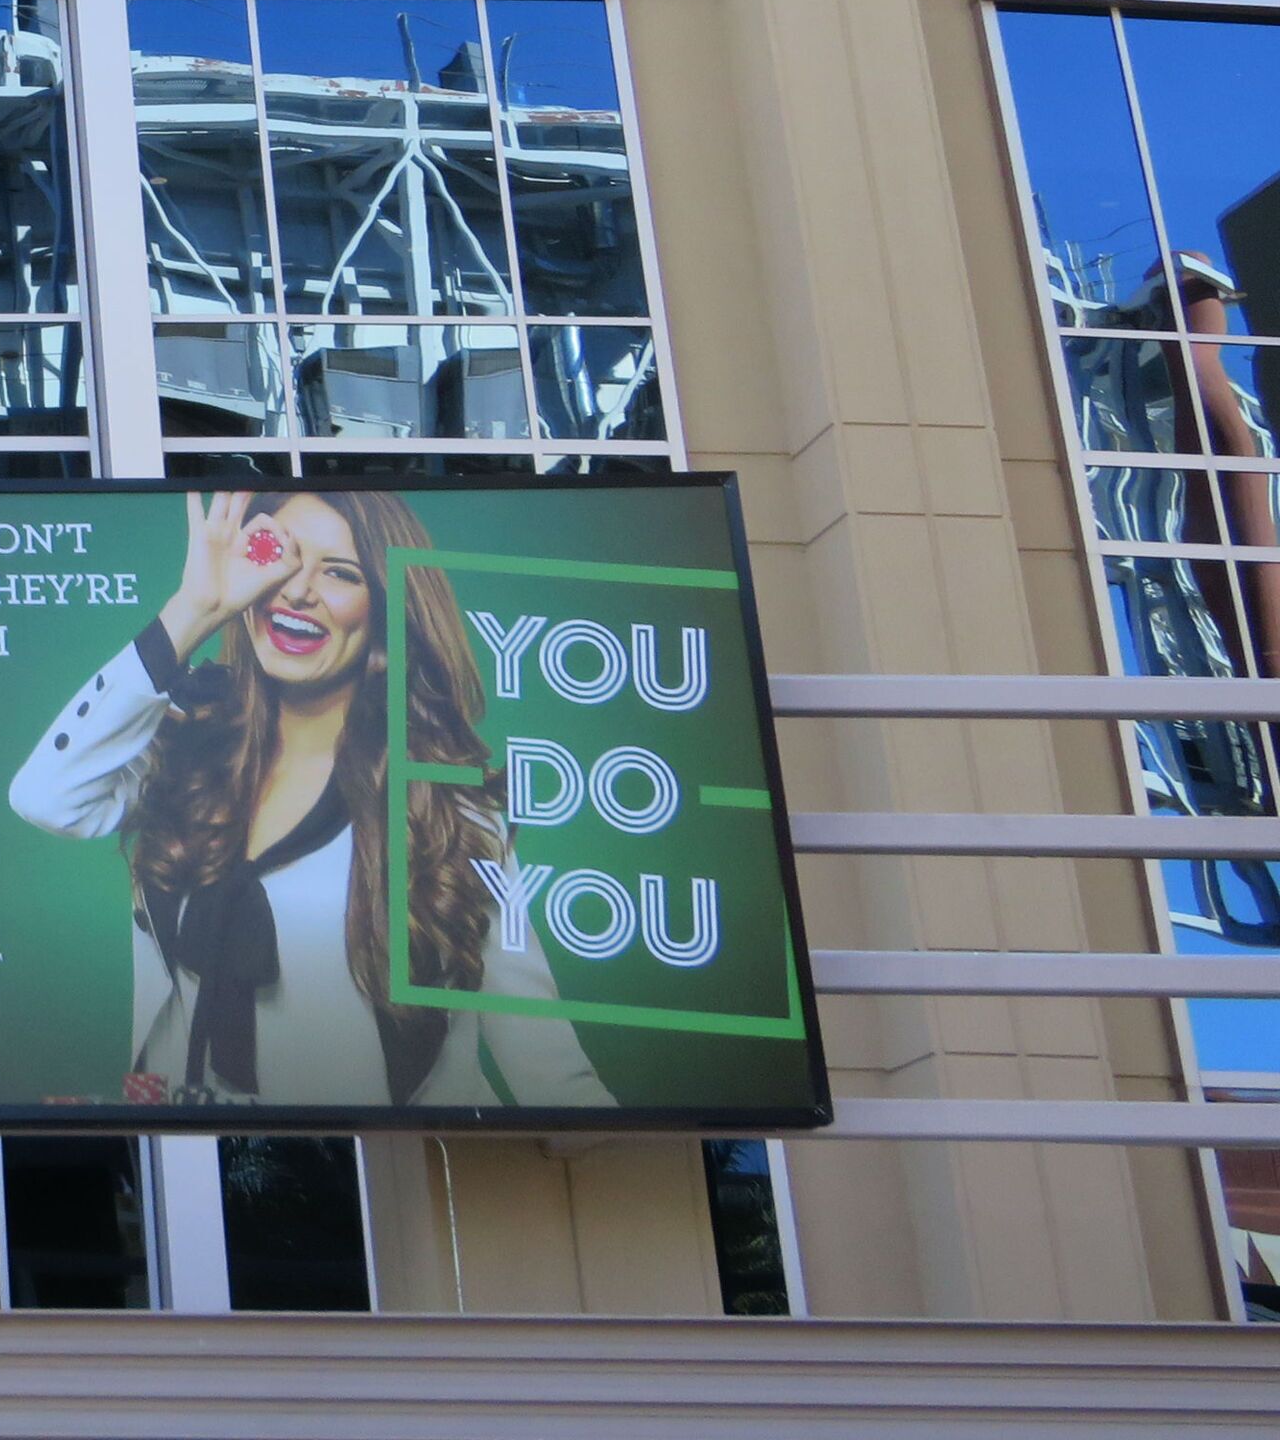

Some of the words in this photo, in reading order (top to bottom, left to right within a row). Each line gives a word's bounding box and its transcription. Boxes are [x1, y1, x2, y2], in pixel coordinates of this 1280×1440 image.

[465, 610, 709, 713] YOU
[506, 737, 680, 835] DO
[468, 858, 721, 967] YOU
